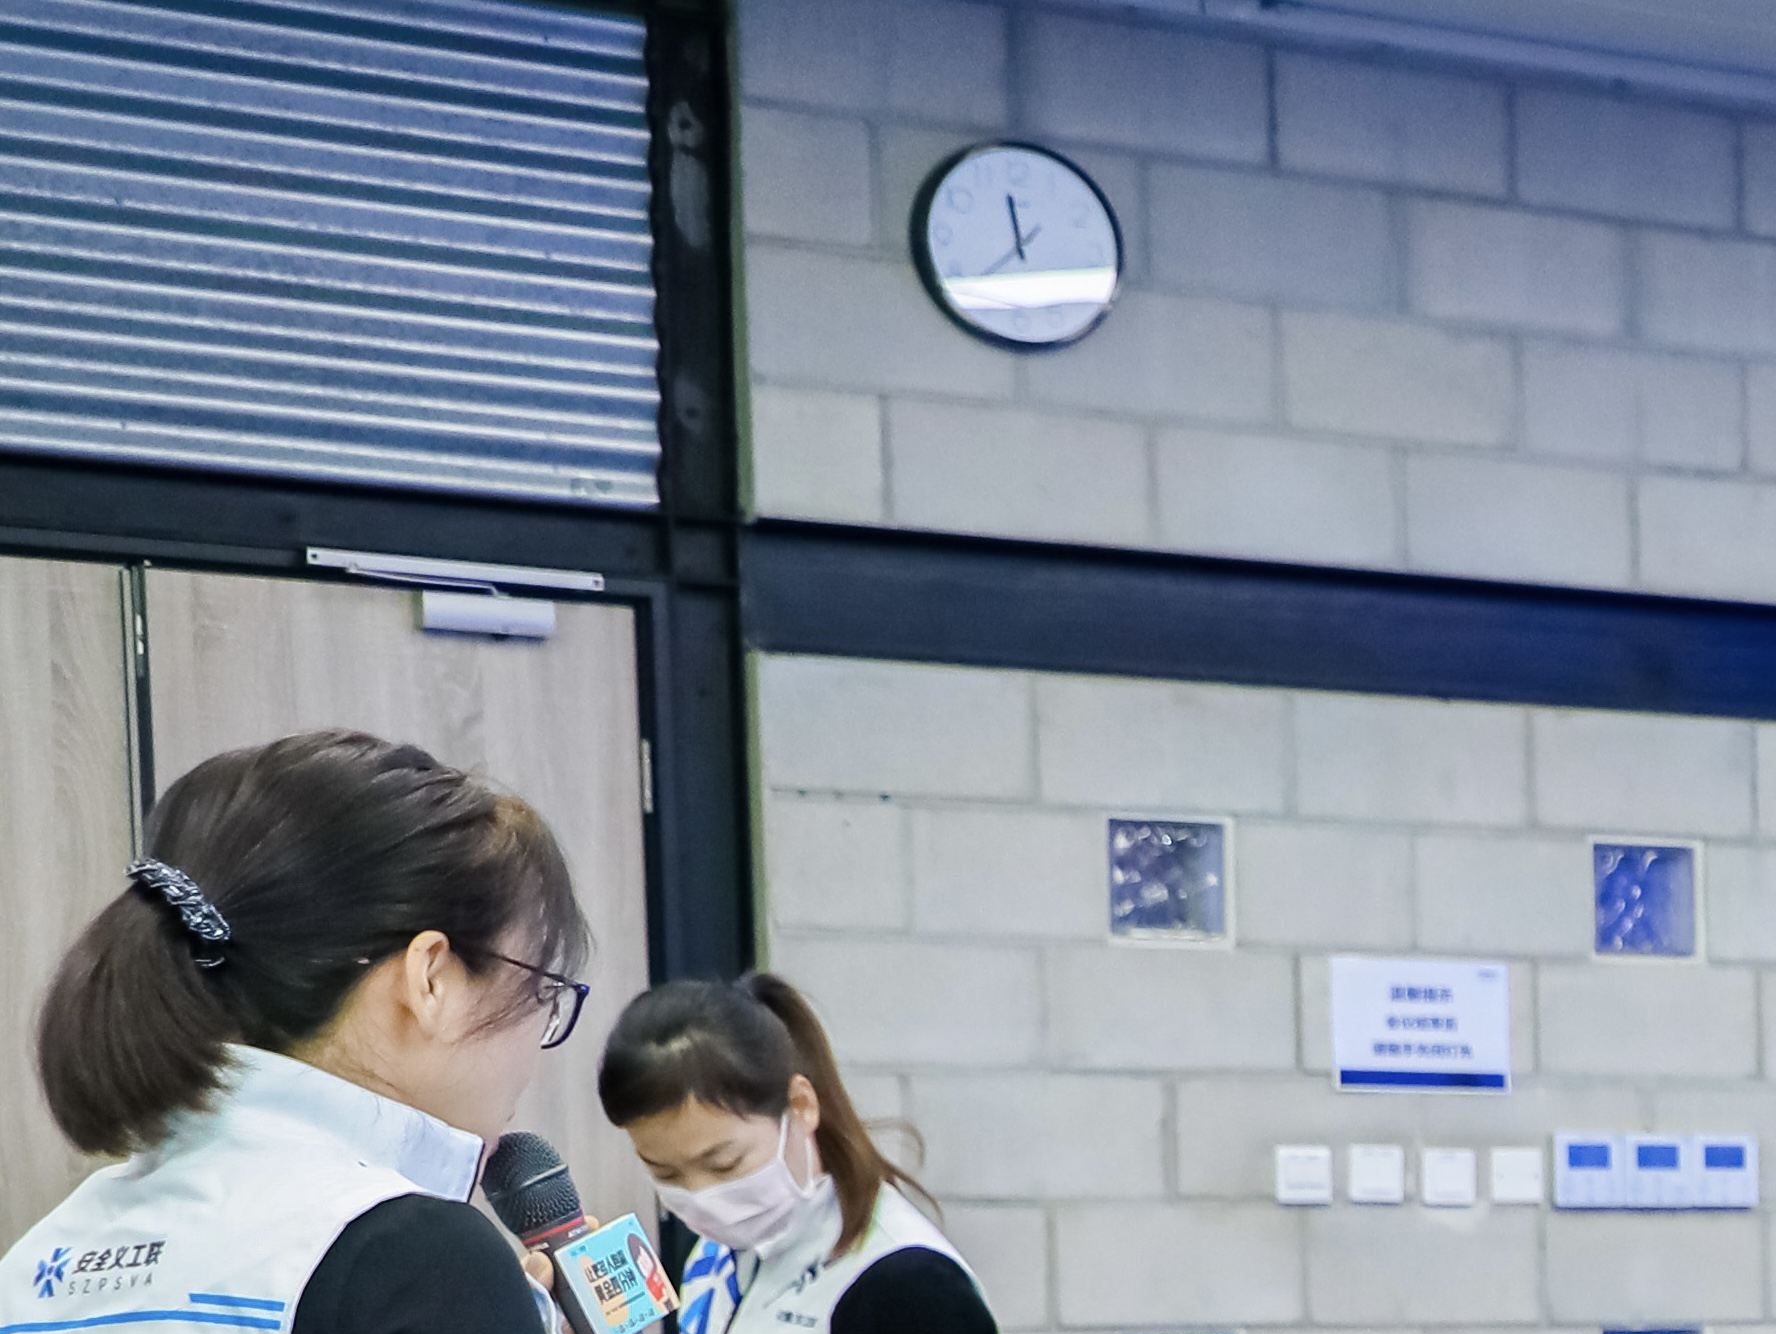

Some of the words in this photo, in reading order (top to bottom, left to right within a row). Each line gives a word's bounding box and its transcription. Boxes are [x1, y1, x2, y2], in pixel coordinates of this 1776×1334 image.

[72, 1240, 167, 1275] 安全义工联
